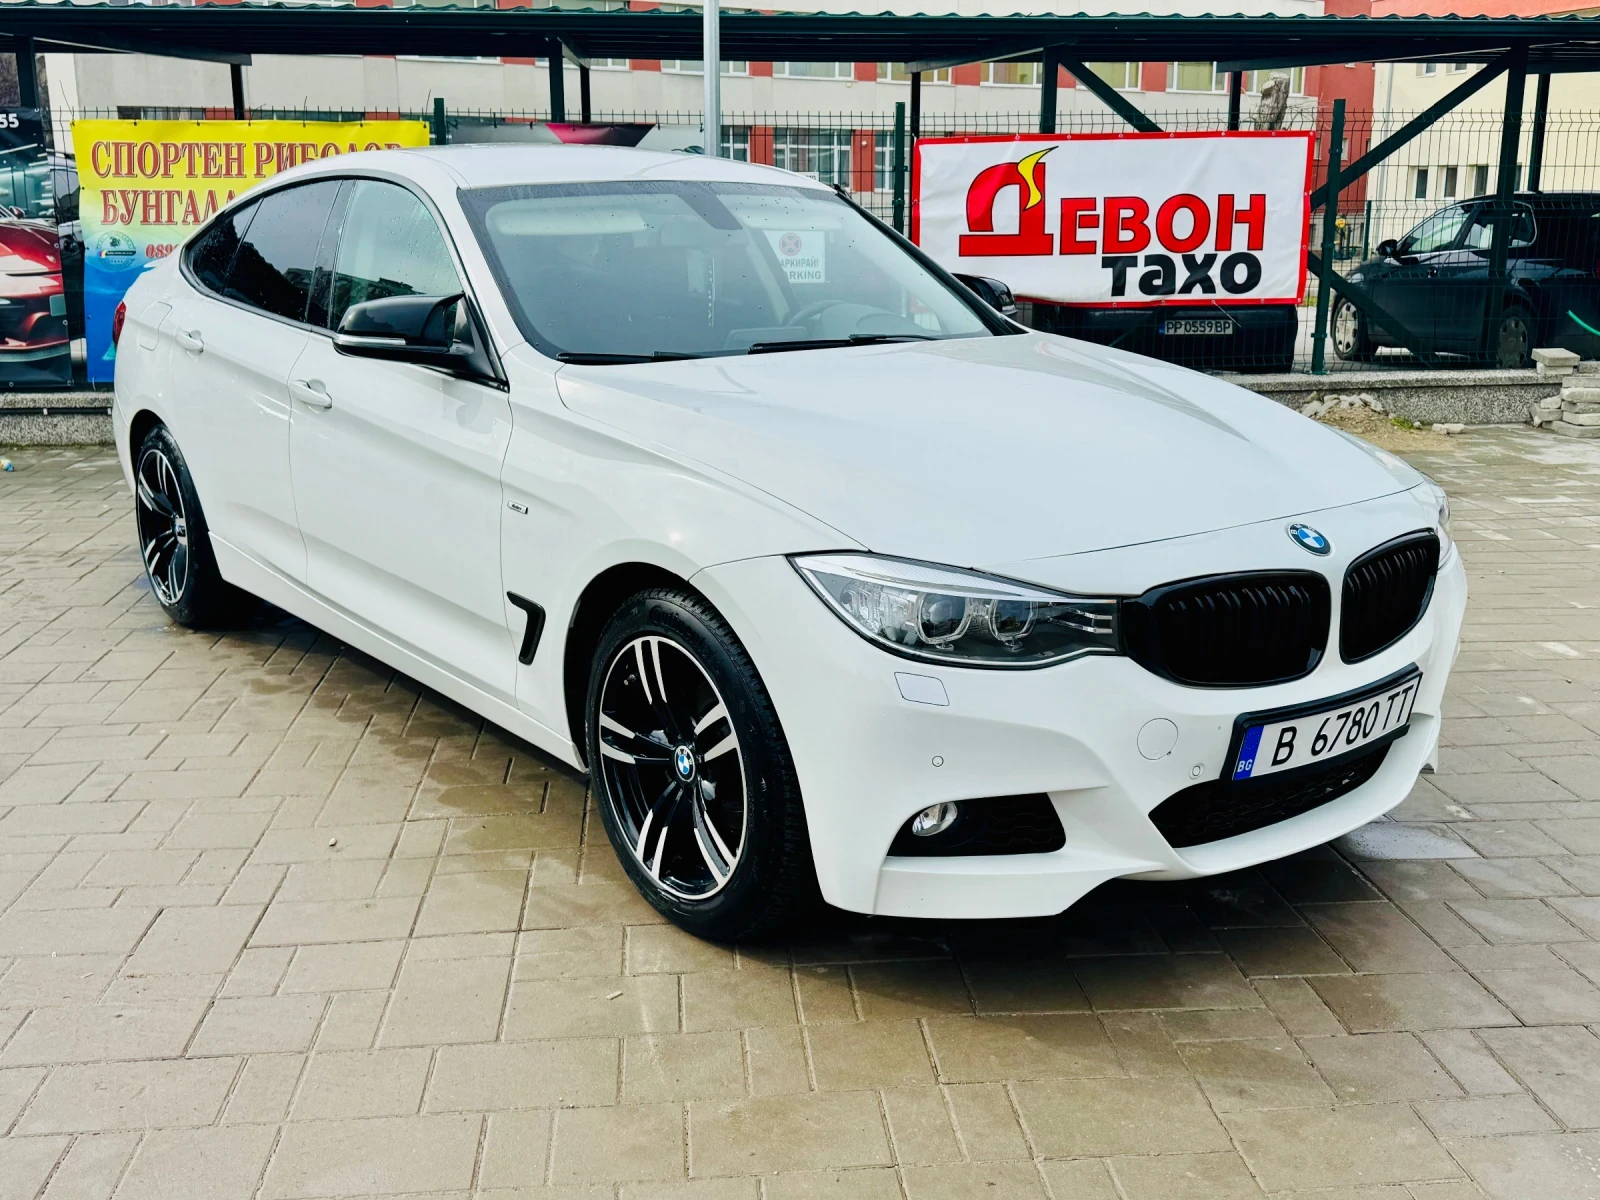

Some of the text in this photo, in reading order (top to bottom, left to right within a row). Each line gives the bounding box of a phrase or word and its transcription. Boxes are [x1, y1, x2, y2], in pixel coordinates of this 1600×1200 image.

[91, 141, 247, 178] СПОРТЕН
[959, 146, 1267, 256] ДЕВОН
[145, 243, 179, 259] 089
[1270, 684, 1414, 767] B 6780 TT
[1236, 759, 1253, 774] BG
